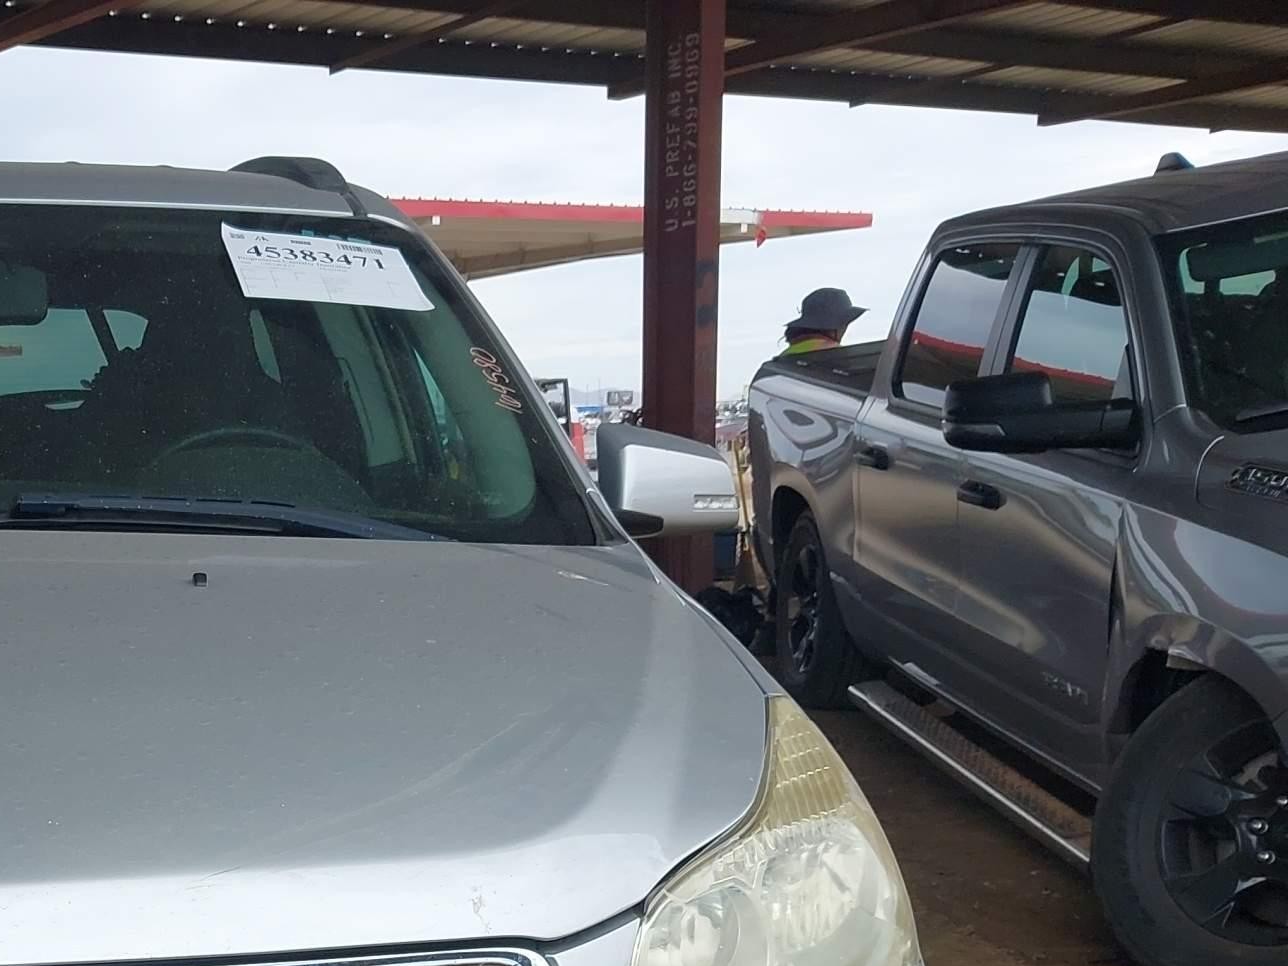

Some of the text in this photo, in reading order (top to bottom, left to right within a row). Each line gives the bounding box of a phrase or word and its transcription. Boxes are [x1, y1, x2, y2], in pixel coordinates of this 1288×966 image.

[665, 35, 683, 232] U.S. PREFAB INC.
[246, 244, 385, 270] 45383471
